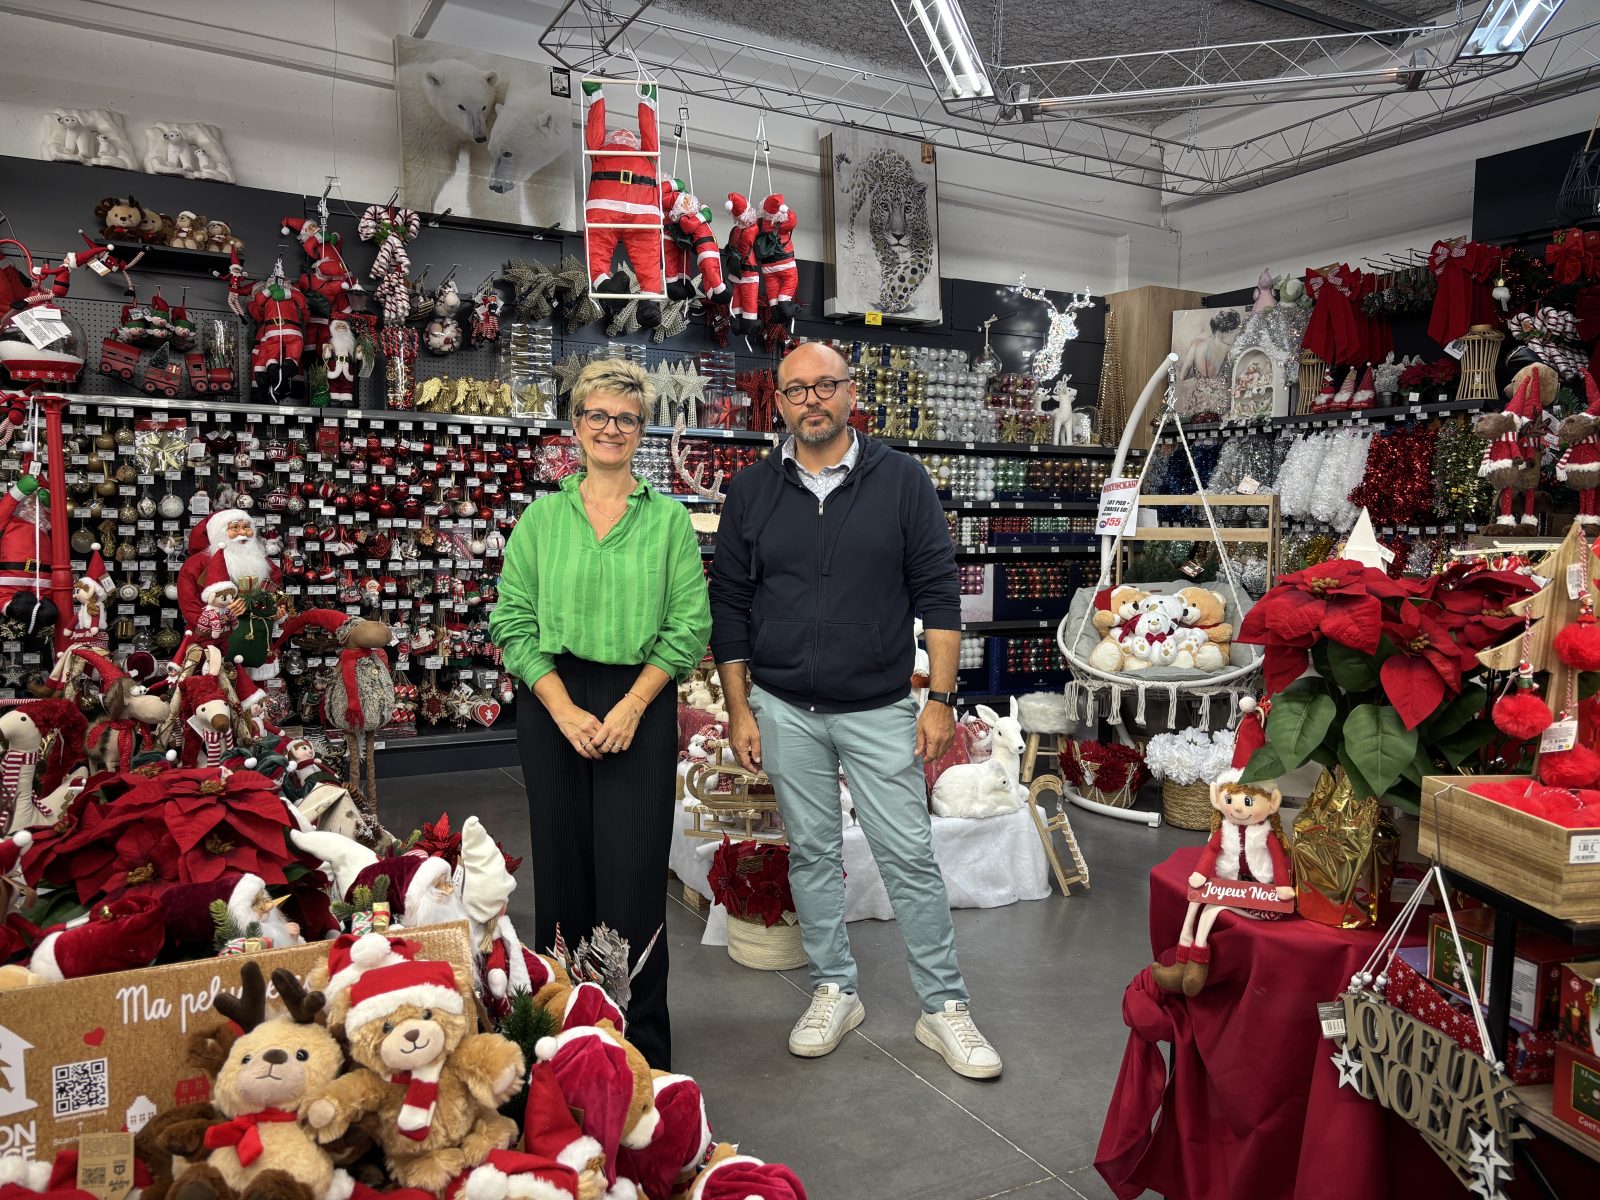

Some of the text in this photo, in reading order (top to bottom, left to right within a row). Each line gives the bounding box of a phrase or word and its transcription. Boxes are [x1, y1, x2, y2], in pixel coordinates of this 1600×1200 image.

[1107, 518, 1121, 526] 155
[1201, 881, 1248, 900] Joyeux
[115, 983, 172, 1025] Ma
[1334, 992, 1516, 1148] JOYEUX
